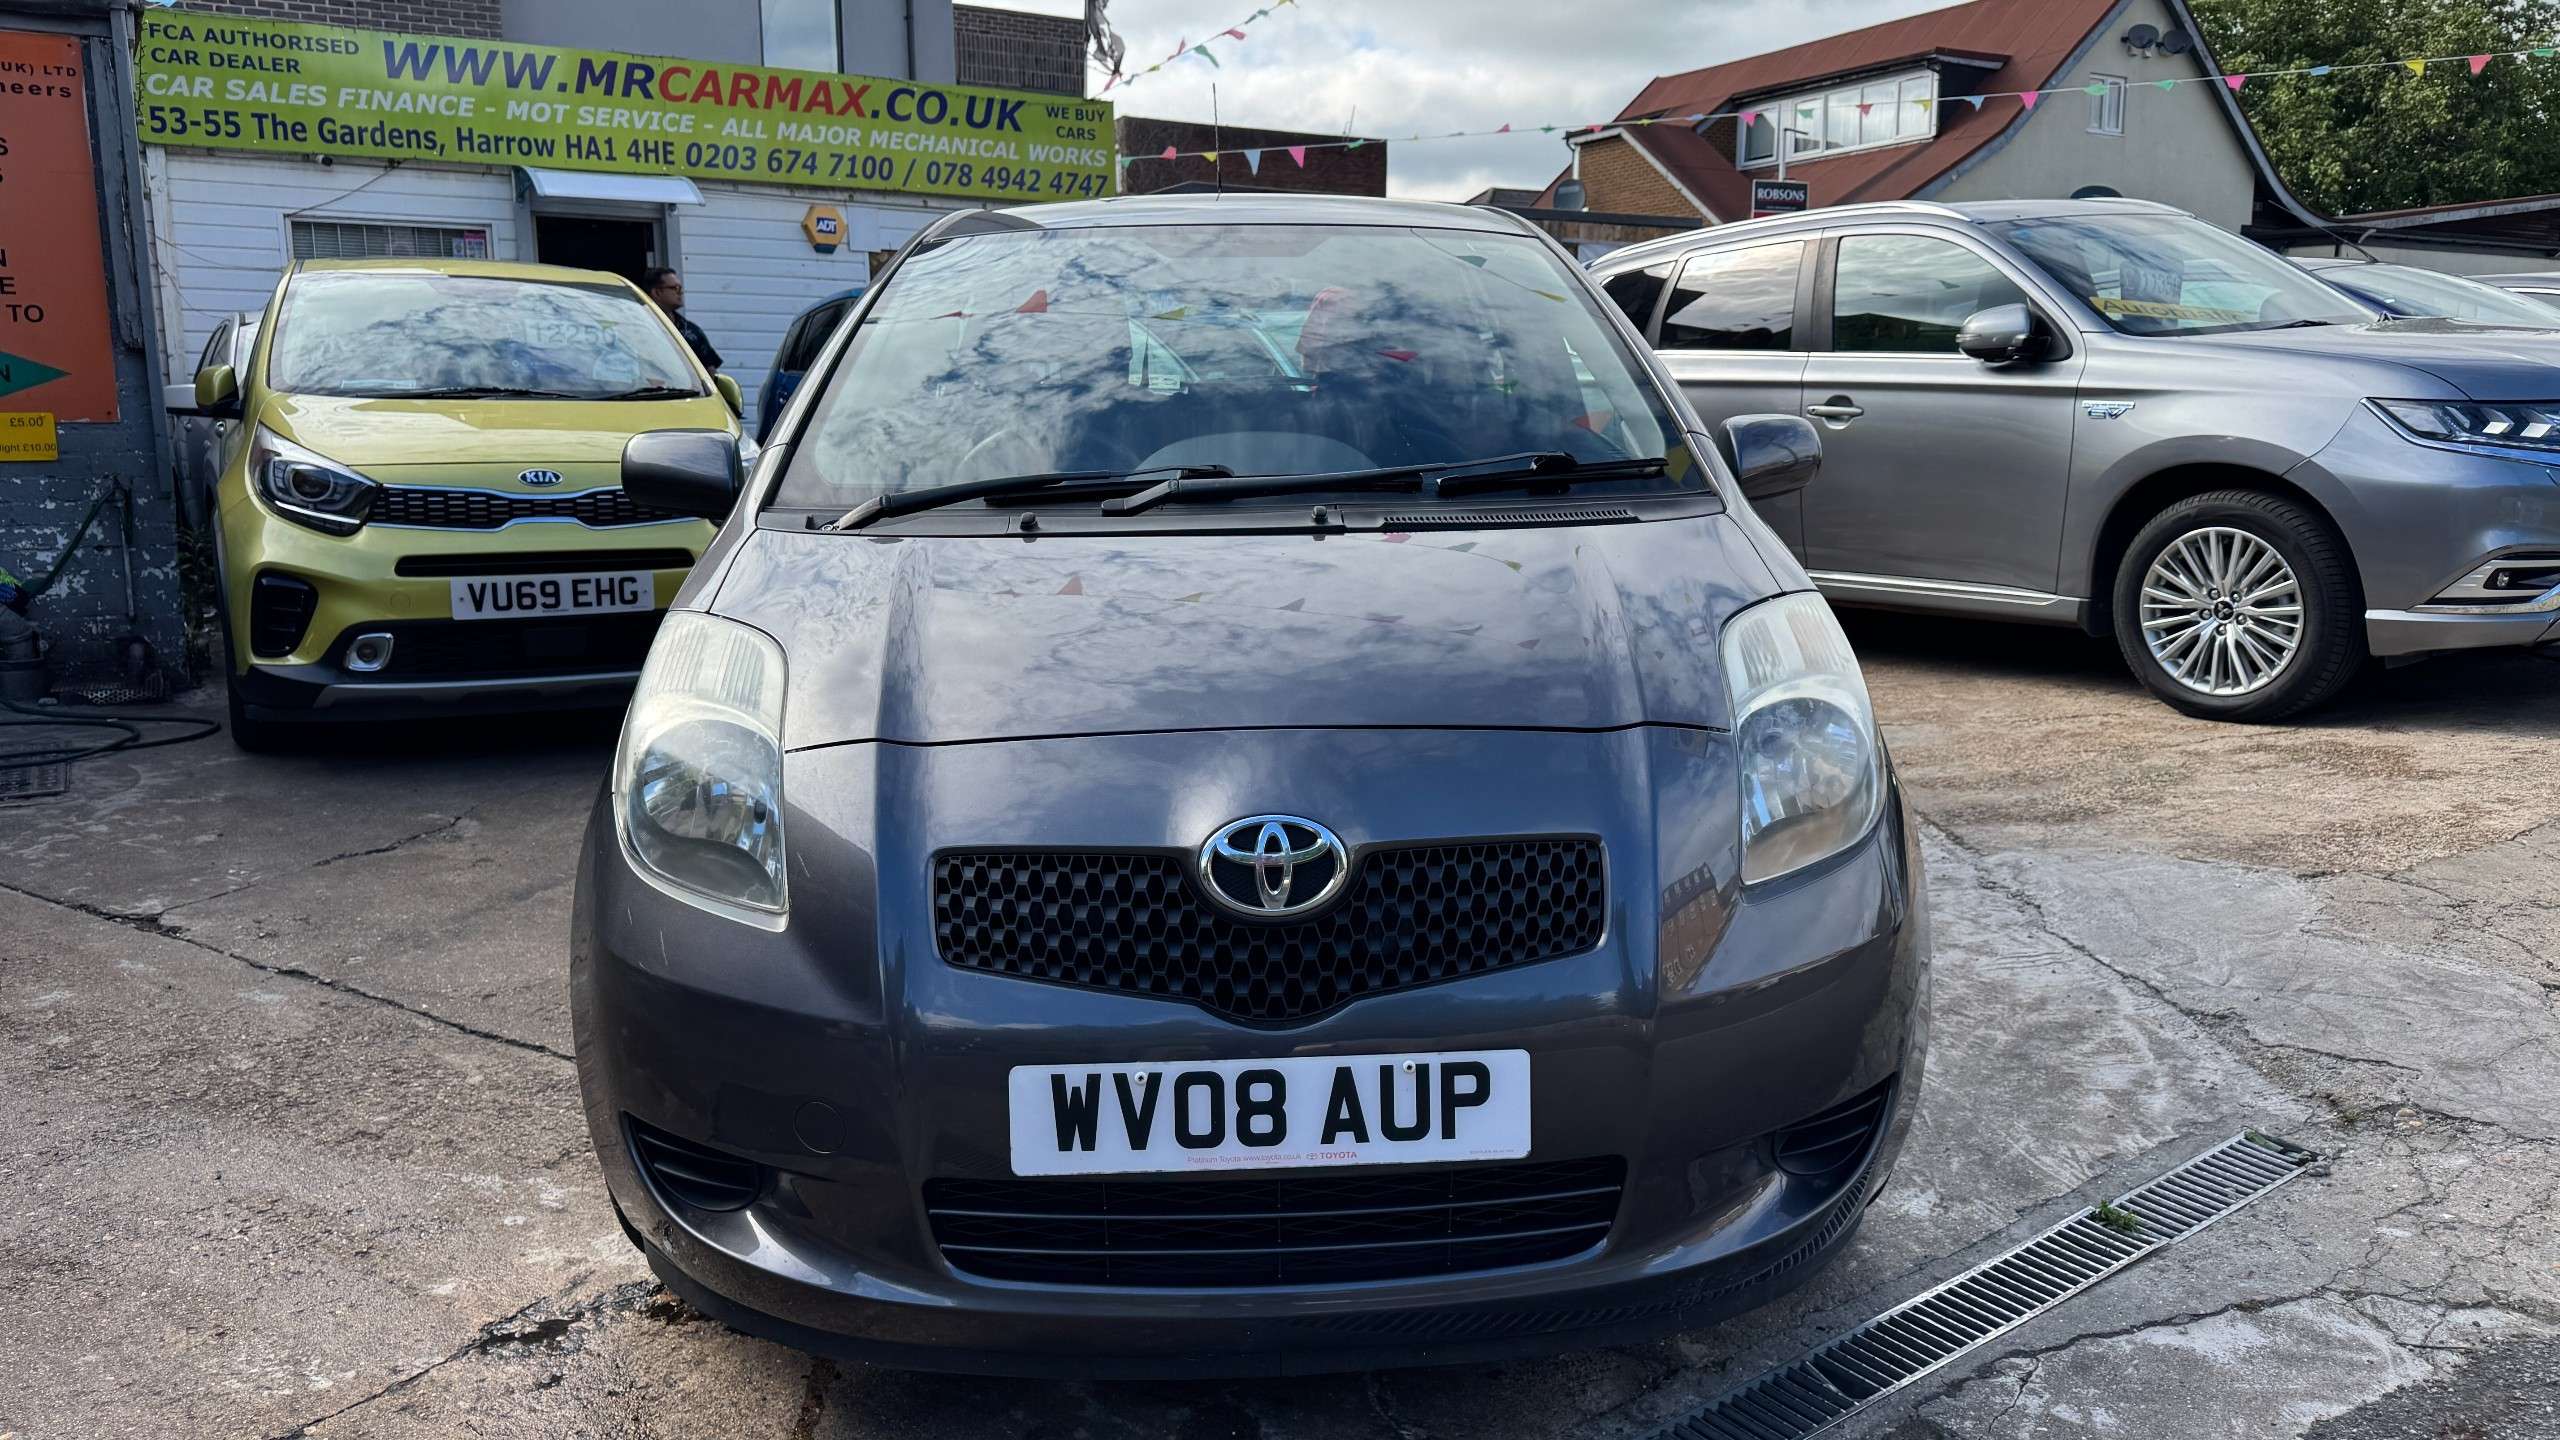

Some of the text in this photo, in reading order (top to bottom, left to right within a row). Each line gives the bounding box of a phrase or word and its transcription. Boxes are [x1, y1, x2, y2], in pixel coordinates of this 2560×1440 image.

[148, 23, 360, 55] FCA AUTHORISED
[151, 48, 301, 74] CAR DEALER
[43, 65, 77, 77] LTD
[383, 40, 1027, 132] WWW.MRCARMAX.CO.UK
[146, 74, 214, 98] CAR
[225, 79, 327, 106] SALES
[338, 88, 475, 117] FINANCE
[506, 101, 570, 124] MOT
[577, 107, 696, 133] SERVICE
[722, 119, 768, 139] ALL
[777, 123, 861, 148] MAJOR
[870, 131, 1020, 160] MECHANICAL
[1029, 144, 1108, 167] WORKS
[1046, 106, 1105, 122] WE BUY
[1056, 126, 1096, 141] CARS
[150, 106, 1108, 197] 53-55 The Gardens, Harrow HA1 4HE 0203 674 7100 / 078 4942 4747
[1757, 188, 1805, 201] ROBSONS
[817, 219, 836, 232] ADT
[6, 304, 44, 323] TO
[9, 417, 43, 428] £5.00
[22, 443, 56, 453] £10.00
[526, 472, 556, 482] KIA
[467, 577, 639, 612] VU69 EHG
[1051, 1062, 1490, 1152] WV08 AUP
[1320, 1151, 1358, 1160] TOYOTA
